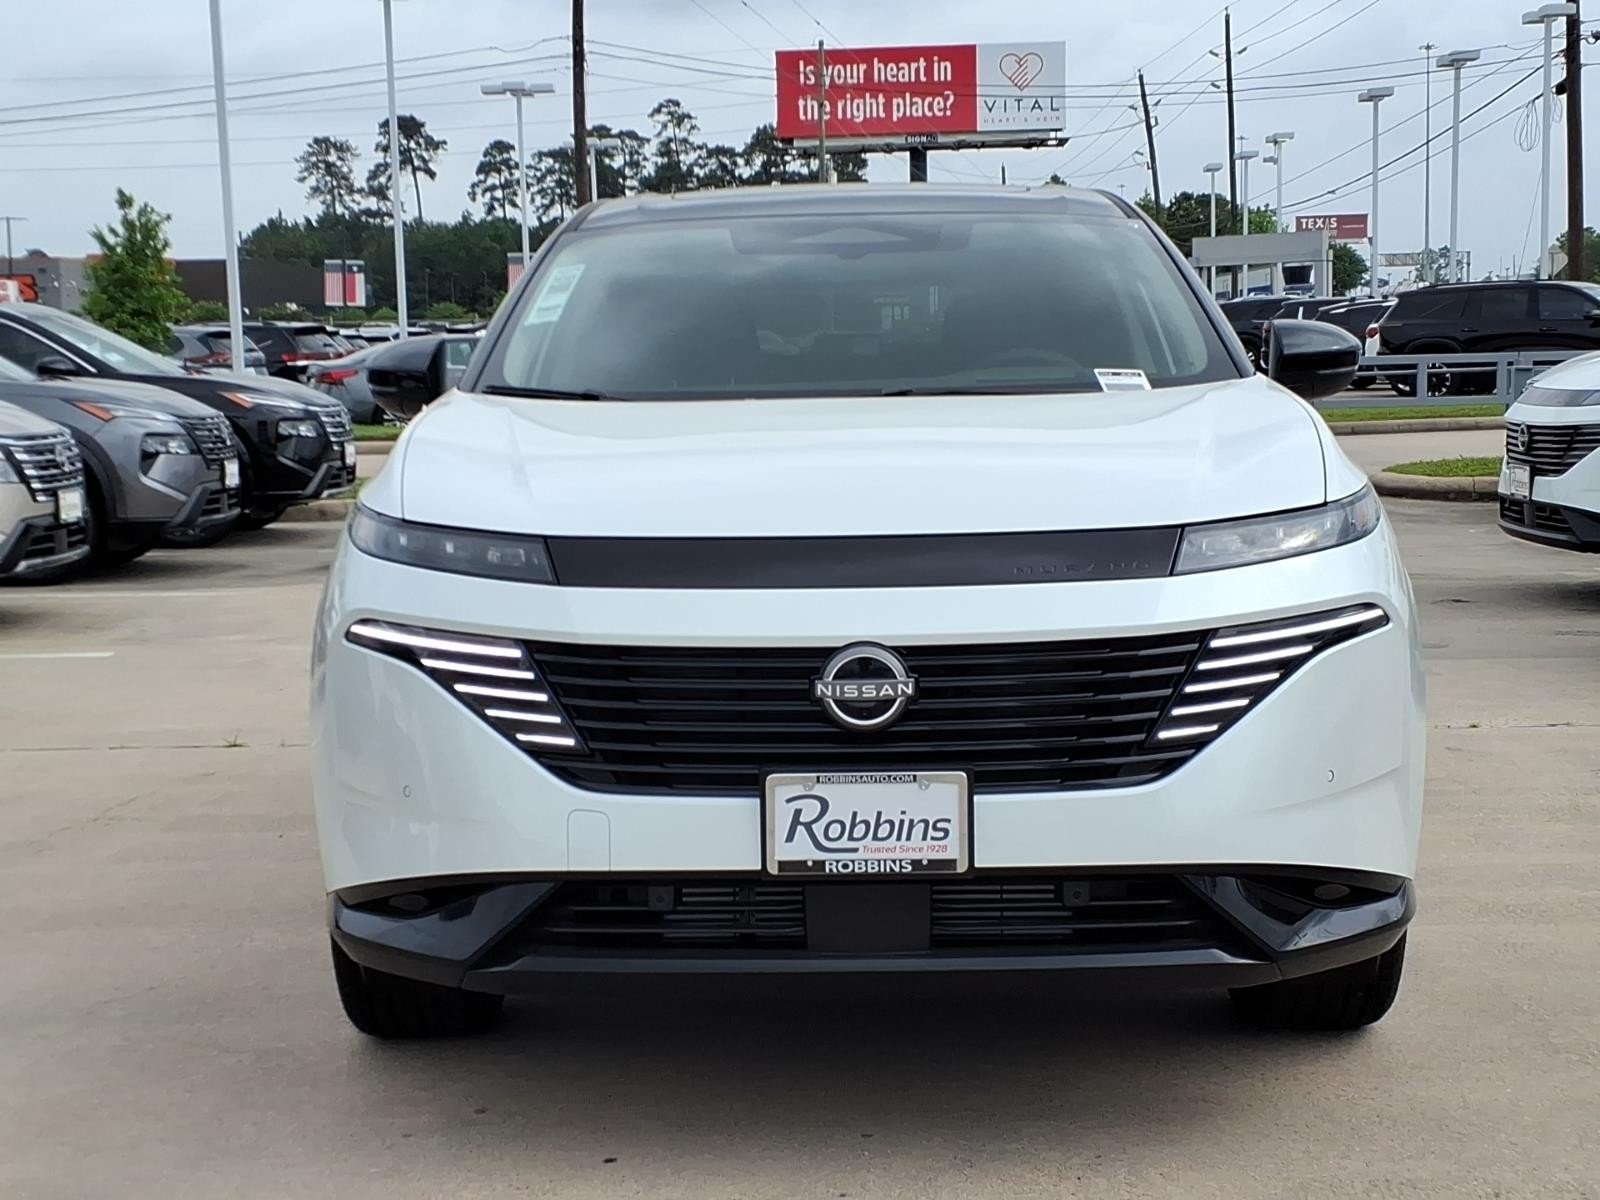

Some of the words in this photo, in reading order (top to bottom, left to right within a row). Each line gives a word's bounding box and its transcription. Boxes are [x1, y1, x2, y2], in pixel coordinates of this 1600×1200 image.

[799, 60, 815, 85] Is
[823, 64, 868, 90] your
[873, 57, 926, 84] heart
[933, 58, 952, 82] in
[798, 95, 831, 121] the
[837, 93, 886, 122] right
[892, 90, 955, 122] place?
[983, 96, 1060, 114] VITAL
[983, 116, 1016, 124] HEART
[1036, 115, 1061, 123] VEIN
[1300, 217, 1338, 230] TEXAS
[816, 682, 914, 697] NISSAN
[819, 774, 914, 784] ROBBINSAUTO.COM
[784, 793, 952, 854] Robbins
[862, 844, 897, 854] Trusted
[899, 844, 924, 853] Since
[926, 844, 948, 853] 1928
[825, 859, 912, 873] ROBBINS
